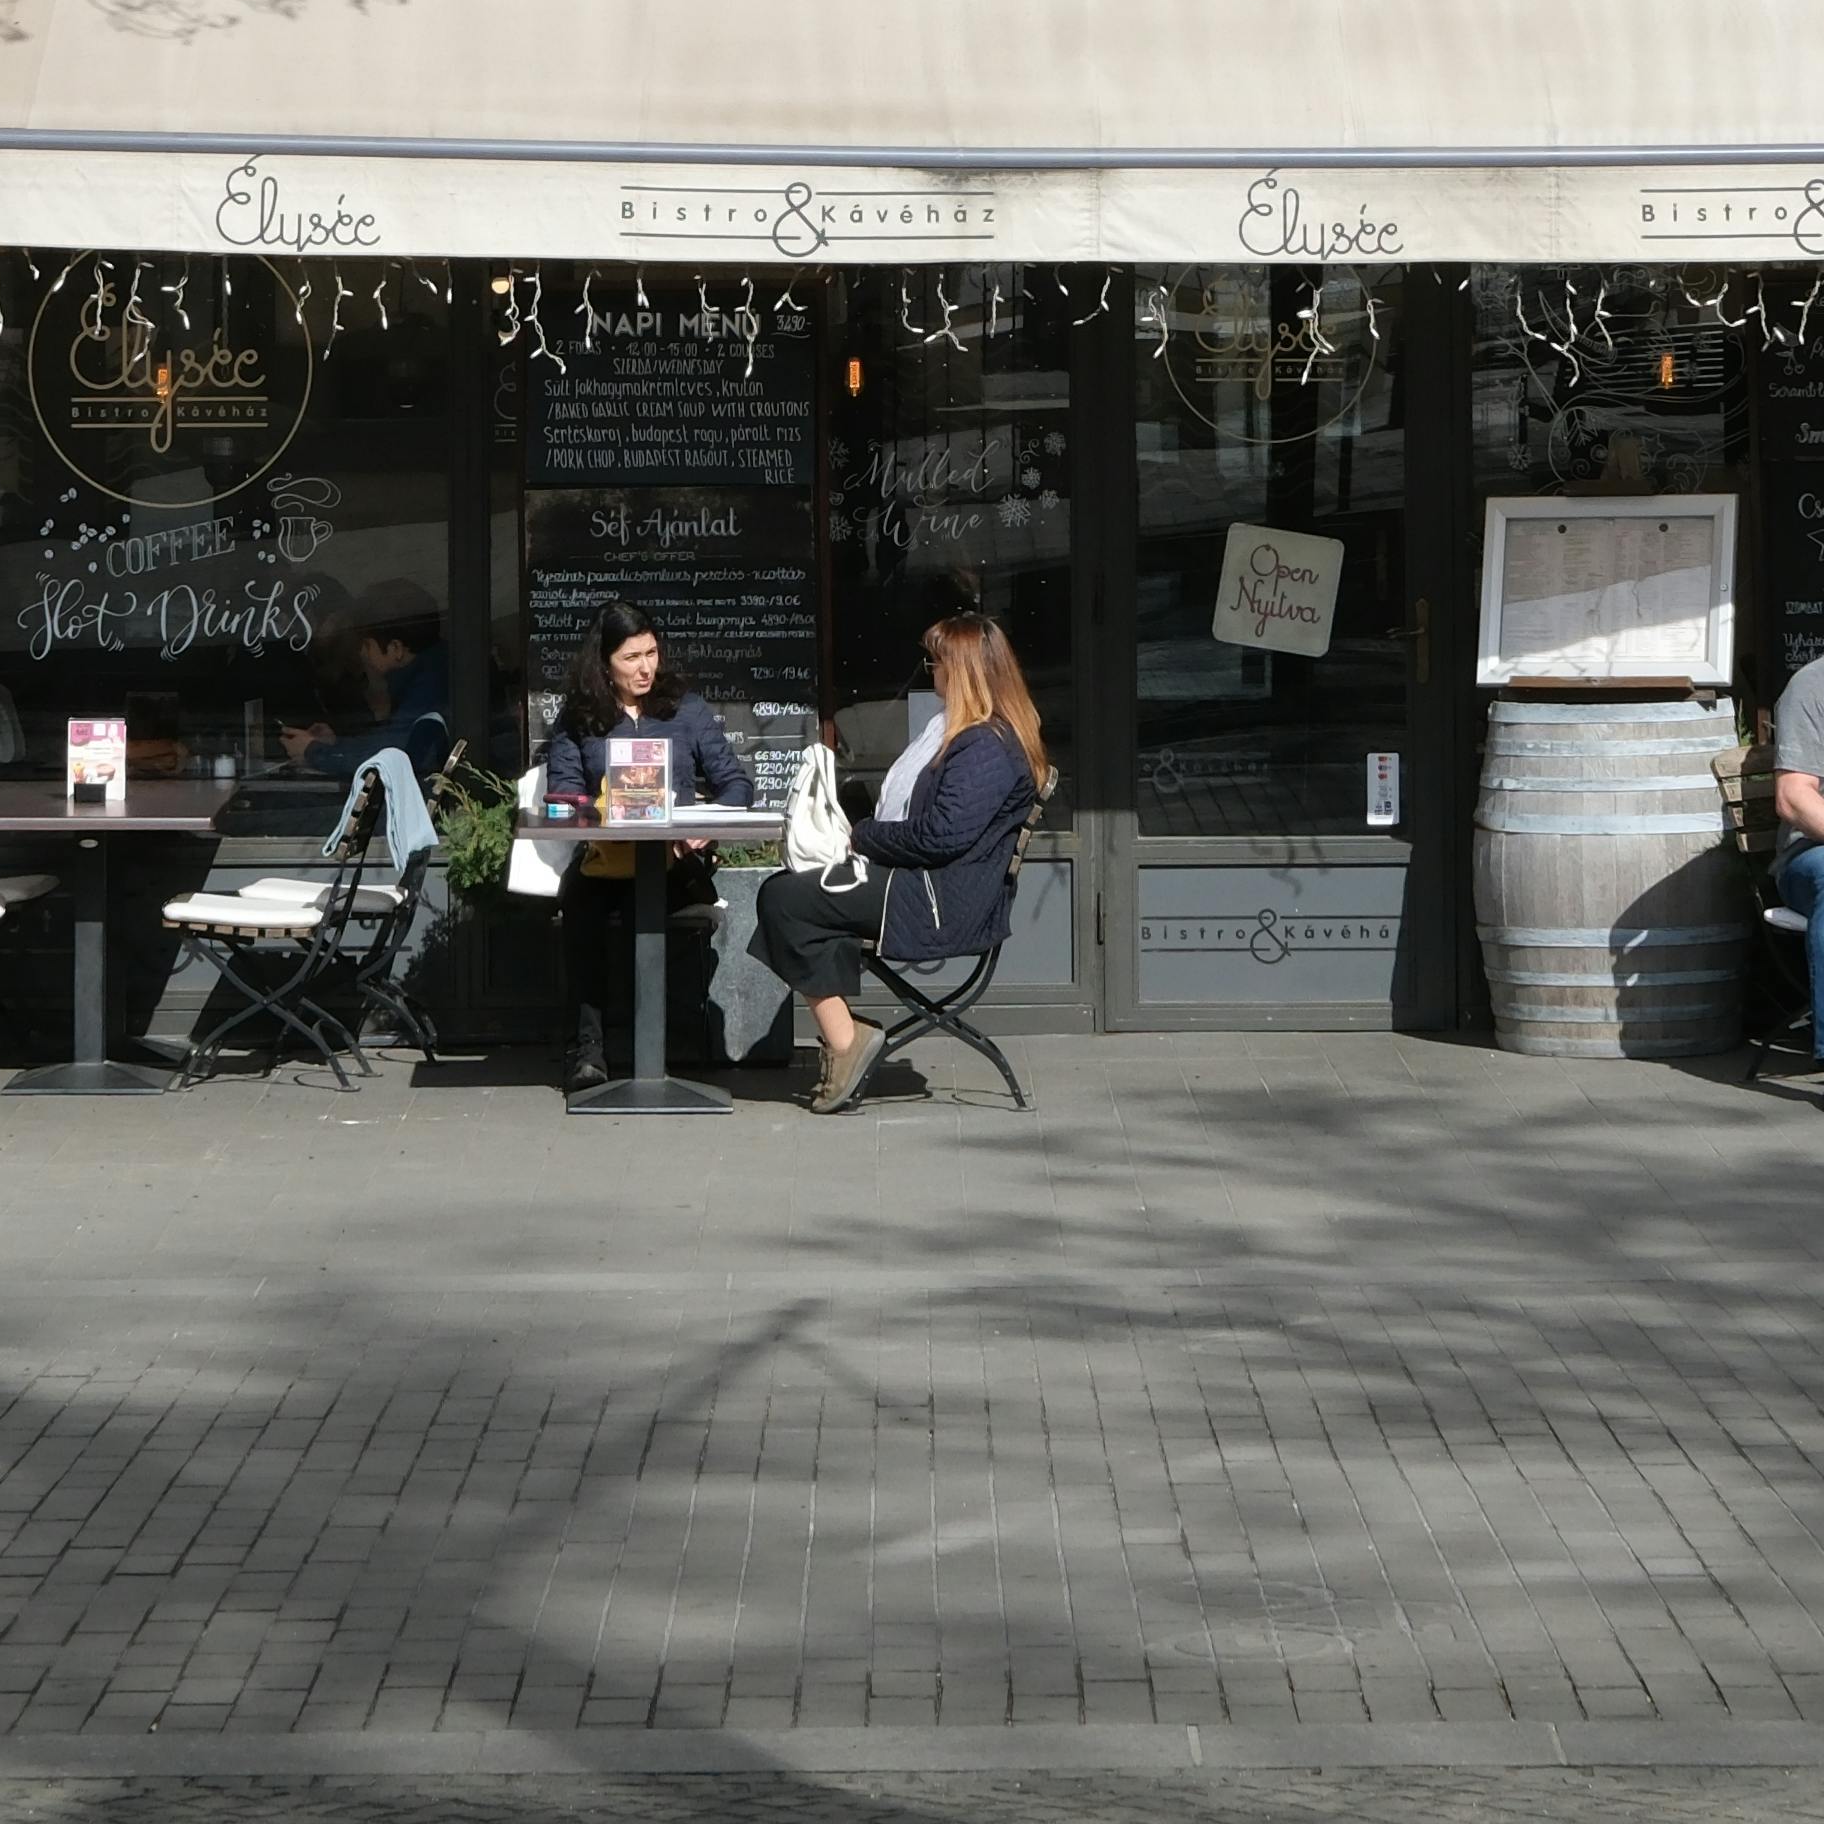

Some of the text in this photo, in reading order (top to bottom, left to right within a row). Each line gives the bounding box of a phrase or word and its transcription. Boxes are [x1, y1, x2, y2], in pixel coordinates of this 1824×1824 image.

[621, 181, 994, 258] Bistro & Kávéház
[1641, 203, 1788, 222] Bistro
[591, 312, 662, 337] NAPI
[555, 340, 565, 355] 2
[717, 343, 725, 357] 2
[729, 342, 775, 358] COUSES
[72, 405, 269, 419] Bistro Kávéház
[591, 402, 630, 419] GARLIC
[636, 402, 674, 418] CREAM
[678, 402, 705, 417] SOUP
[712, 402, 745, 418] WITH
[750, 401, 810, 417] CROUTONS
[624, 450, 681, 469] BUDAPEST
[738, 449, 792, 468] STEAMED
[765, 468, 795, 485] RICE
[842, 439, 1001, 548] Mulled Wine
[589, 504, 742, 548] Séf Ajánlat
[106, 516, 236, 578] COFFEE
[653, 551, 696, 562] OFFER
[1250, 544, 1319, 597] Open
[17, 578, 314, 661] Hot Drinks
[1229, 576, 1320, 637] Nyitva
[1142, 909, 1389, 964] Bistro & Kávéhá
